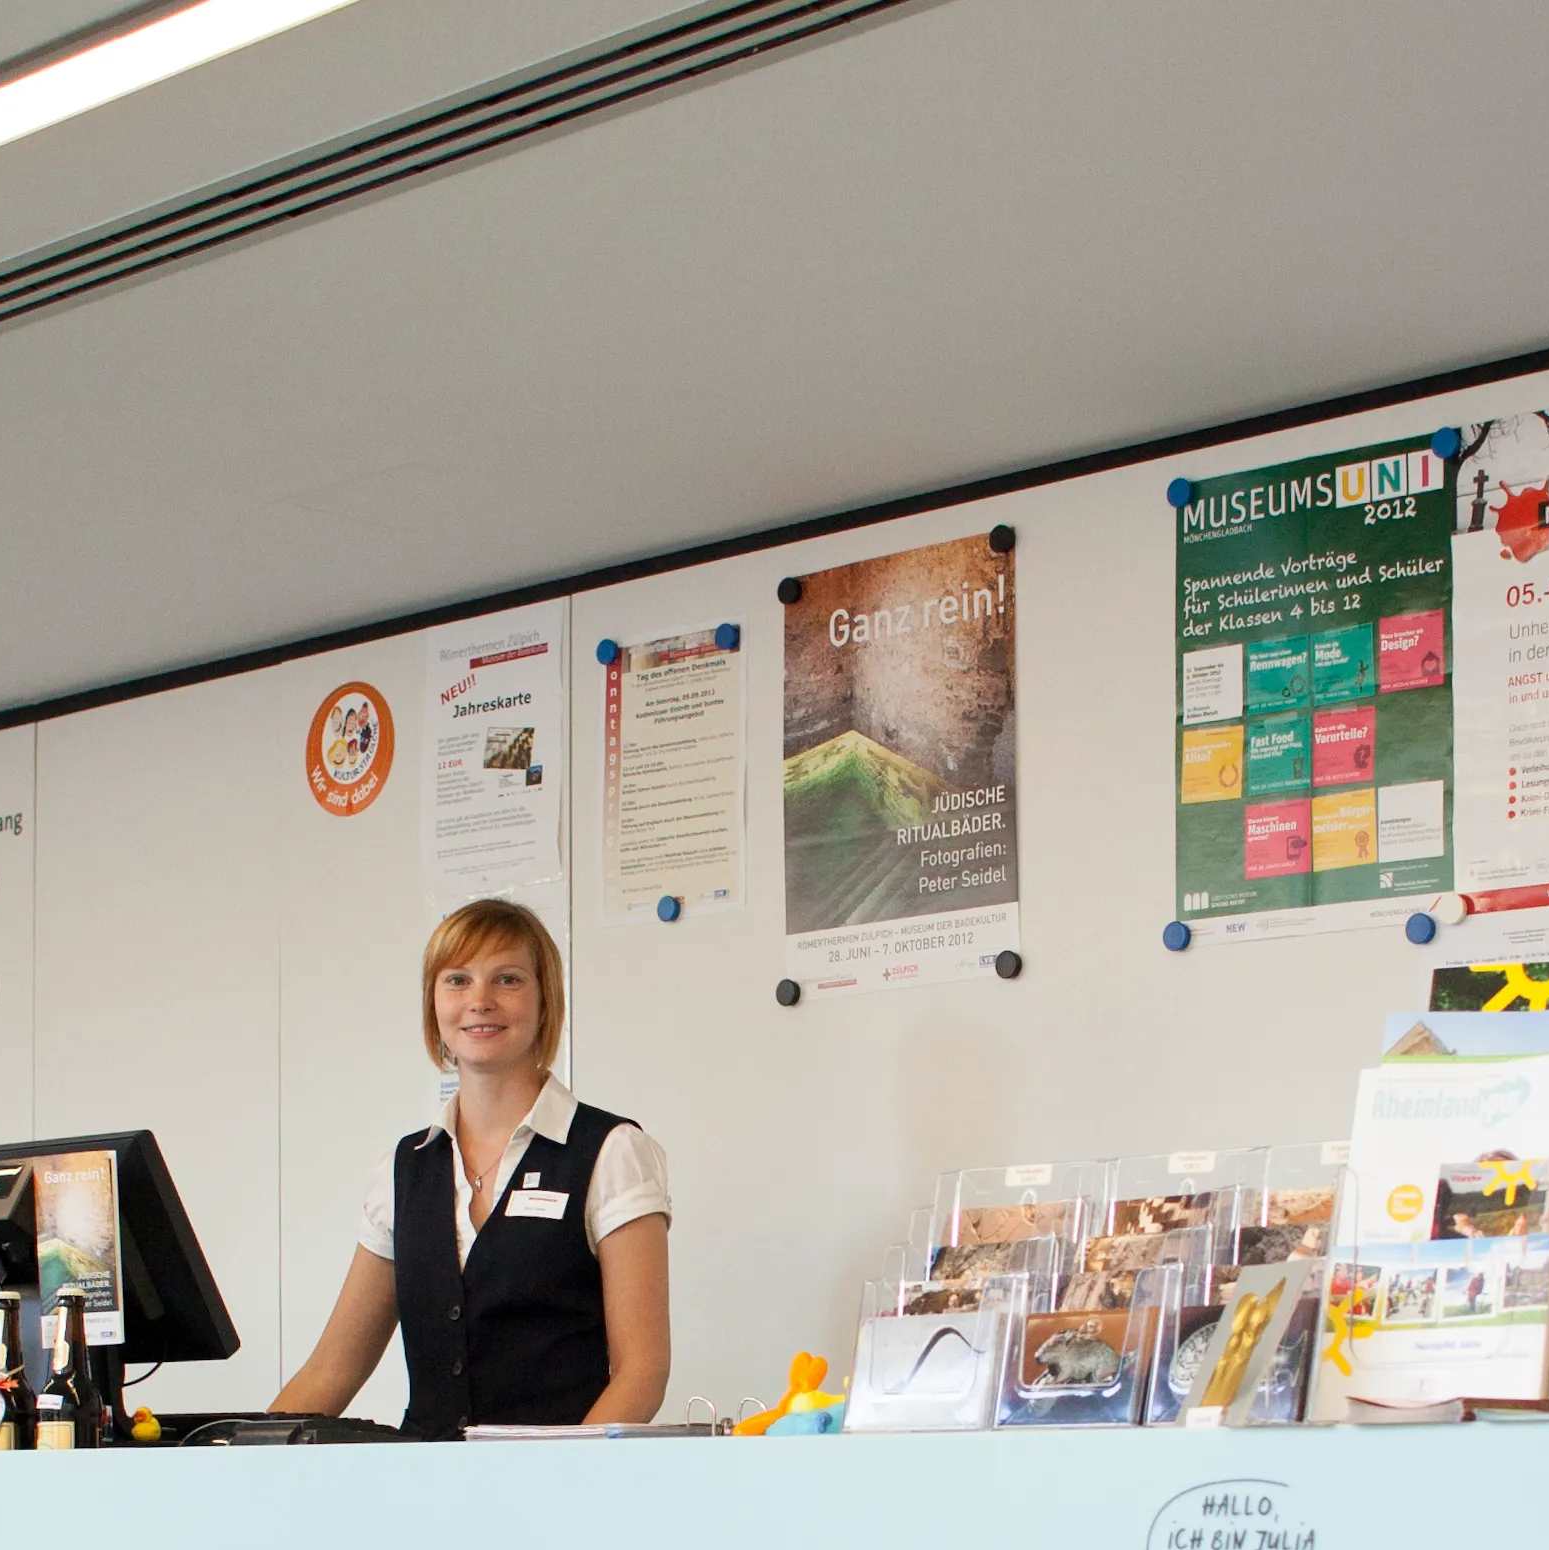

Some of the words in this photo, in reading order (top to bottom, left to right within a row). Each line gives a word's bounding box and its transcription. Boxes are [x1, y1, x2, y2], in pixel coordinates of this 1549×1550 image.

[1364, 498, 1417, 526] 2012
[1184, 524, 1252, 545] MÖNCHENGLADBACH
[1184, 566, 1275, 598] Spannende
[1282, 552, 1357, 578] Vorträge
[1184, 599, 1211, 620] für
[1218, 579, 1329, 611] Schülerinnen
[1336, 566, 1373, 588] und
[1379, 559, 1444, 583] Schüler
[829, 604, 910, 647] Ganz
[923, 574, 1005, 628] rein!
[1183, 622, 1212, 638] der
[1219, 609, 1282, 632] Klassen
[1291, 608, 1302, 619] 4
[1311, 599, 1335, 616] bis
[1343, 594, 1361, 610] 12
[1315, 648, 1342, 662] Mode
[1381, 636, 1419, 652] Design?
[1509, 648, 1522, 663] in
[636, 673, 649, 682] Tag
[651, 671, 663, 679] des
[664, 665, 690, 677] offenen
[692, 659, 726, 673] Denkmals
[1251, 652, 1308, 672] Rennwagen?
[440, 673, 477, 705] NEU!!
[1508, 671, 1542, 688] ANGST
[452, 692, 532, 718] Jahreskarte
[1509, 693, 1518, 704] in
[1521, 689, 1539, 701] und
[1251, 734, 1268, 747] Fast
[1271, 731, 1294, 744] Food
[1315, 727, 1368, 744] Vorurteile?
[448, 759, 462, 768] EUR
[312, 765, 327, 792] Wir
[327, 790, 349, 807] sind
[931, 785, 1005, 814] JÜDISCHE
[897, 813, 1006, 845] RITUALBÄDER.
[1248, 819, 1297, 836] Maschinen
[921, 842, 1007, 867] Fotografien:
[919, 876, 957, 893] Peter
[962, 865, 1006, 887] Seidel
[798, 933, 859, 950] RÖMERTHERMEN
[861, 929, 893, 942] ZÜLPICH
[901, 923, 935, 937] MUSEUM
[937, 921, 952, 932] DER
[955, 913, 1007, 928] BADEKULTUR
[1226, 923, 1246, 934] NEW
[829, 951, 843, 963] 28.
[846, 946, 871, 960] JUNI
[883, 944, 892, 956] 7.
[894, 936, 945, 954] OKTOBER
[948, 932, 974, 946] 2012
[44, 1171, 71, 1184] Ganz
[75, 1168, 106, 1182] rein!
[1202, 1495, 1279, 1522] HALLO,
[1168, 1520, 1204, 1550] ICH
[1211, 1522, 1246, 1550] BIN
